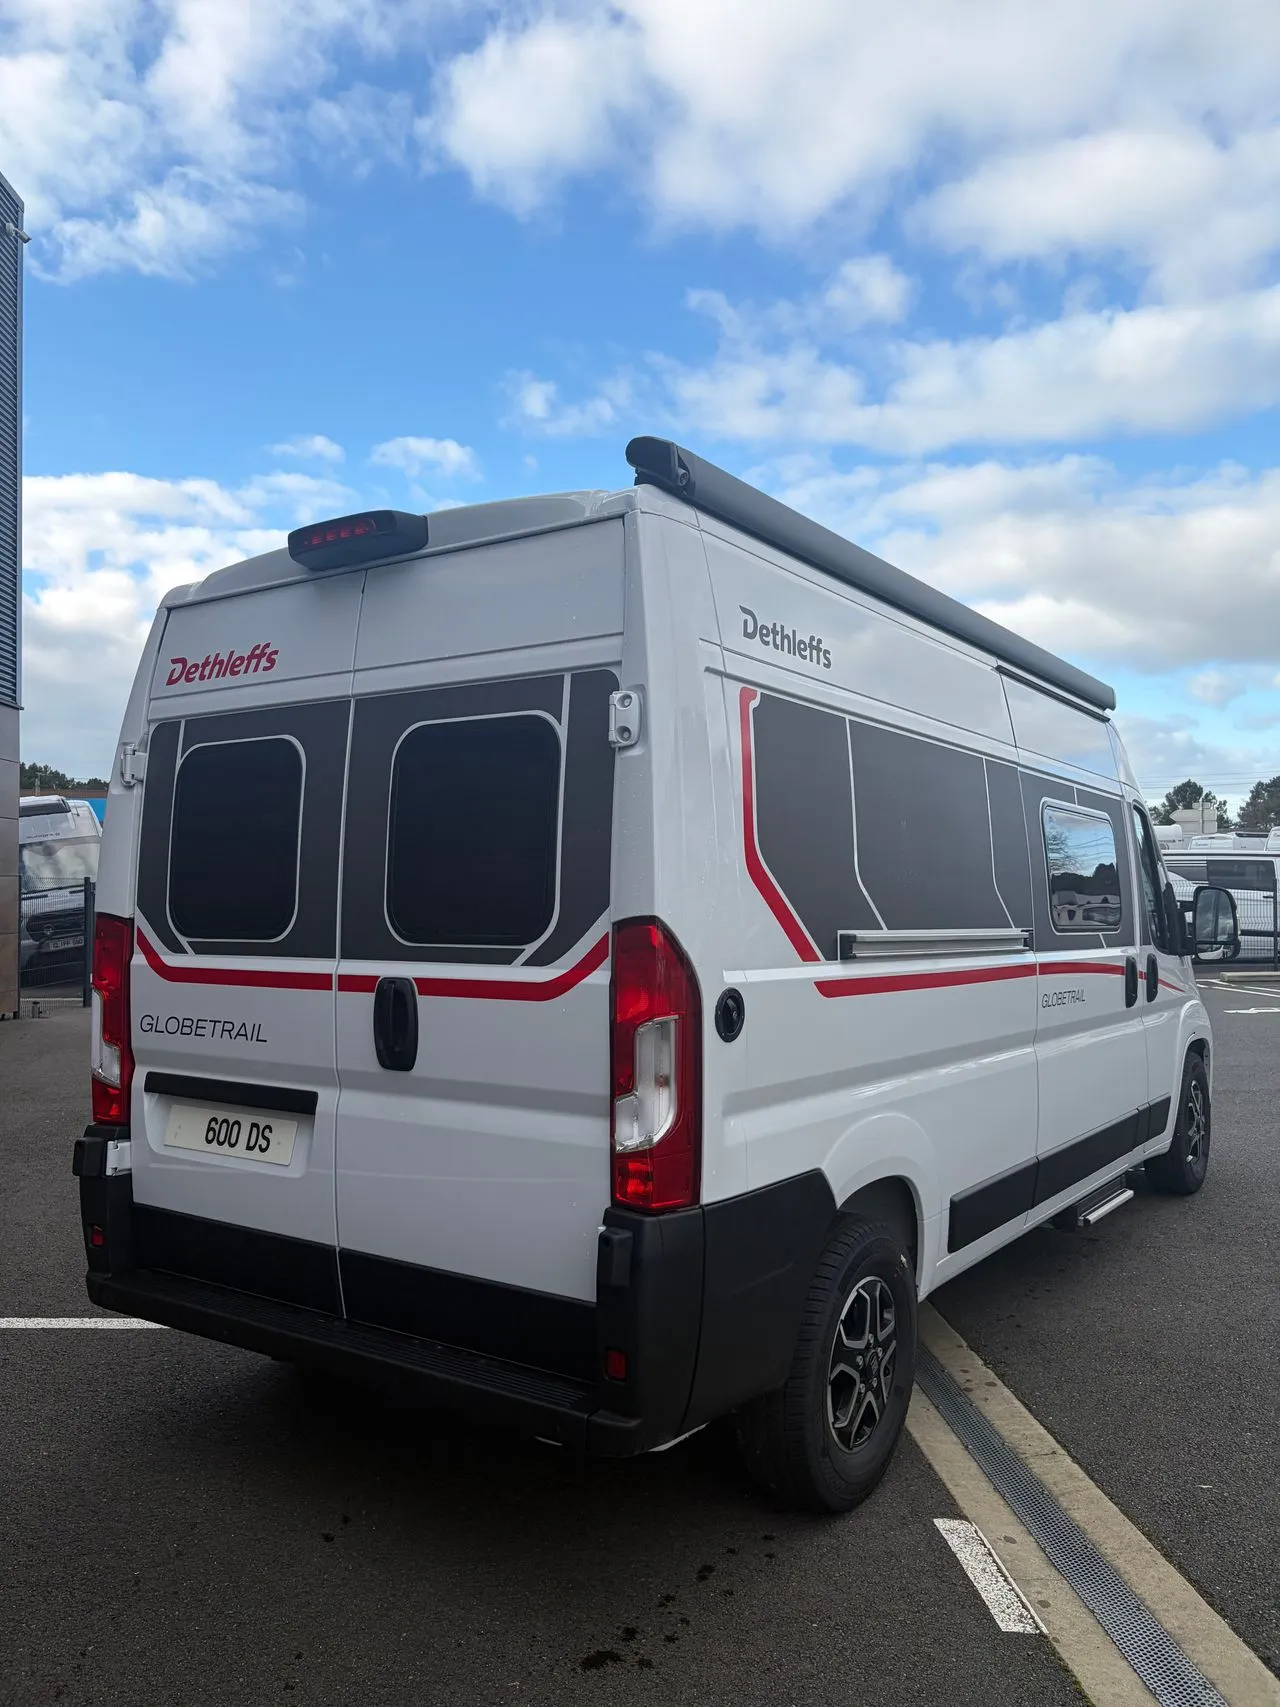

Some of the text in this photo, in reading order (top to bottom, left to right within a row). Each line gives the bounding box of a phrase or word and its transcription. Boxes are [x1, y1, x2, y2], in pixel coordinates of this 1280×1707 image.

[739, 604, 832, 669] Dethleffs
[166, 642, 279, 686] Dethleffs
[1041, 989, 1086, 1008] GLOBETRAIL
[140, 1014, 268, 1043] GLOBETRAIL
[205, 1116, 273, 1153] 600 DS
